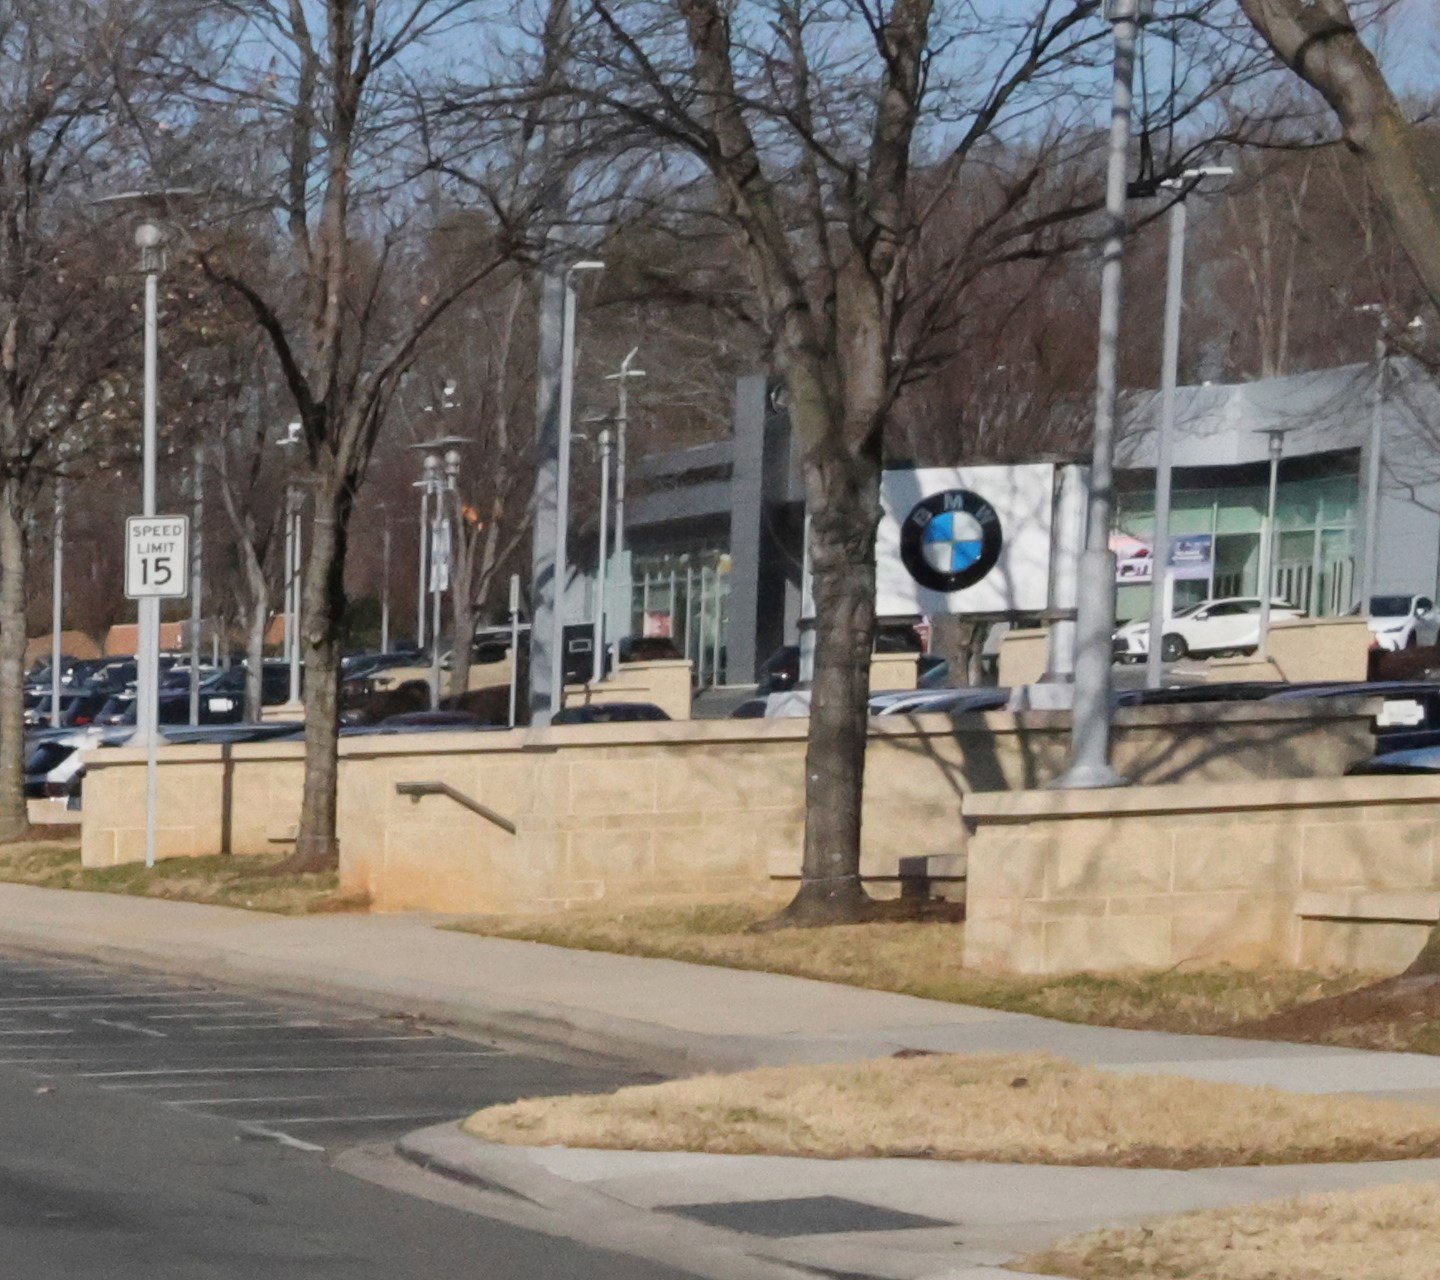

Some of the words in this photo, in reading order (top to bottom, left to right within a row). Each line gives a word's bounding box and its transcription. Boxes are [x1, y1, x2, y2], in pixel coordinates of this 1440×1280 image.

[133, 525, 182, 537] SPEED
[137, 542, 175, 554] LIMIT
[141, 557, 172, 586] 15
